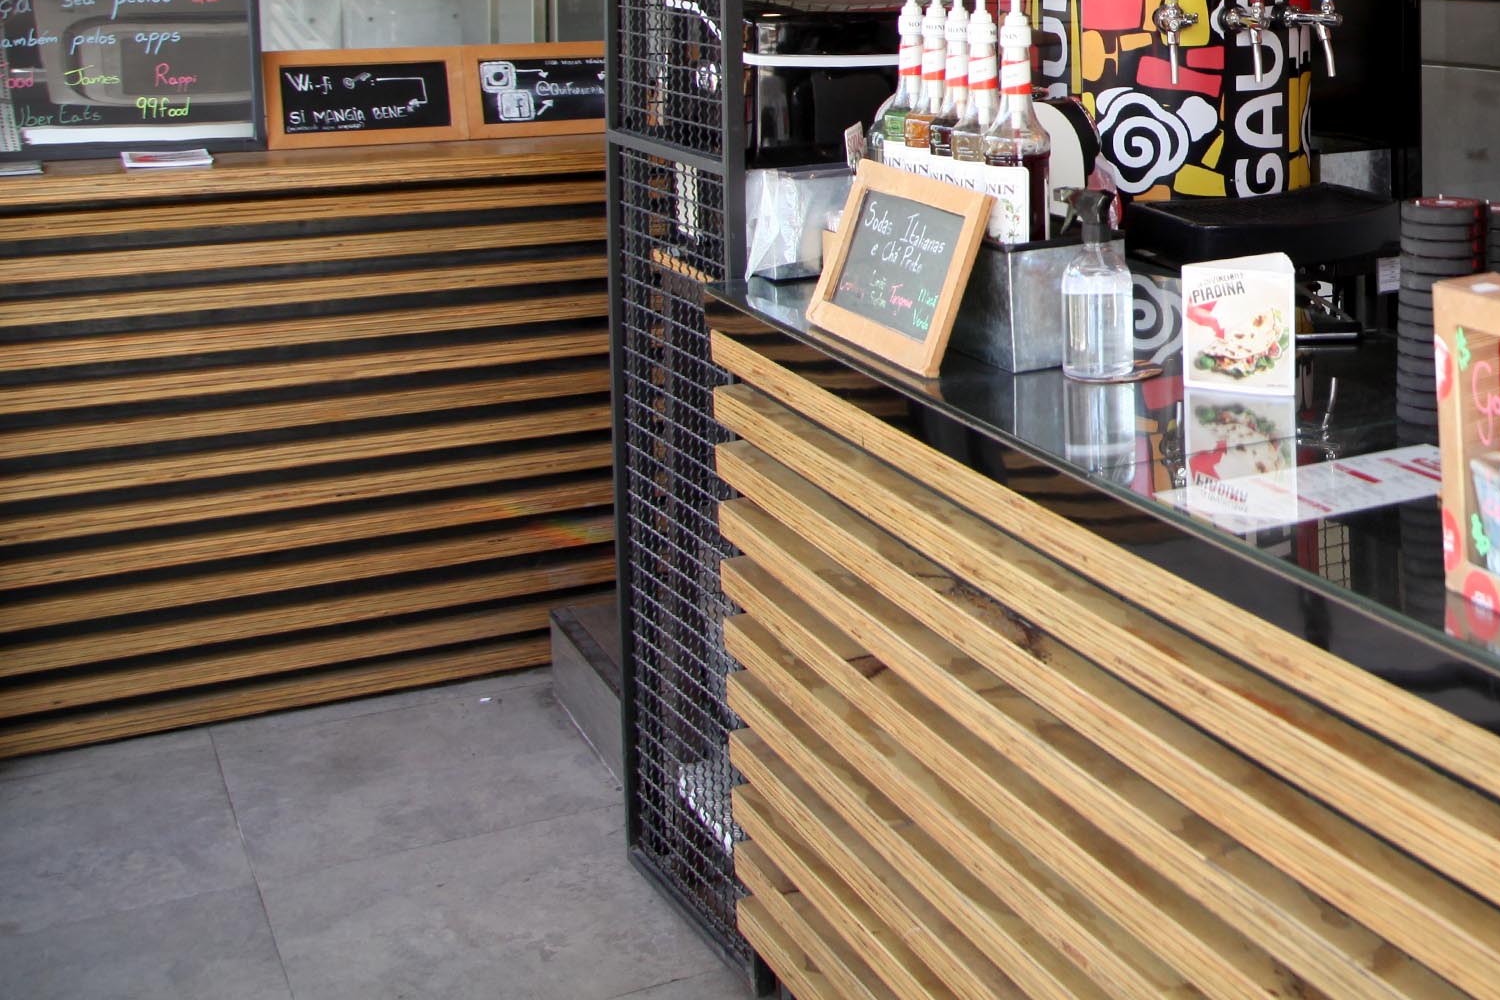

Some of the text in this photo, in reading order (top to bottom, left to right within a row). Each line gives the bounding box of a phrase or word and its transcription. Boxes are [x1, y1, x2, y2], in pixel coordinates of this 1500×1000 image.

[1, 28, 181, 55] ambém pelos apps
[64, 65, 121, 86] James
[154, 63, 198, 92] Rappi
[59, 104, 102, 123] Eats
[864, 201, 946, 254] Sodas Italianas
[1192, 280, 1246, 304] PIADINA
